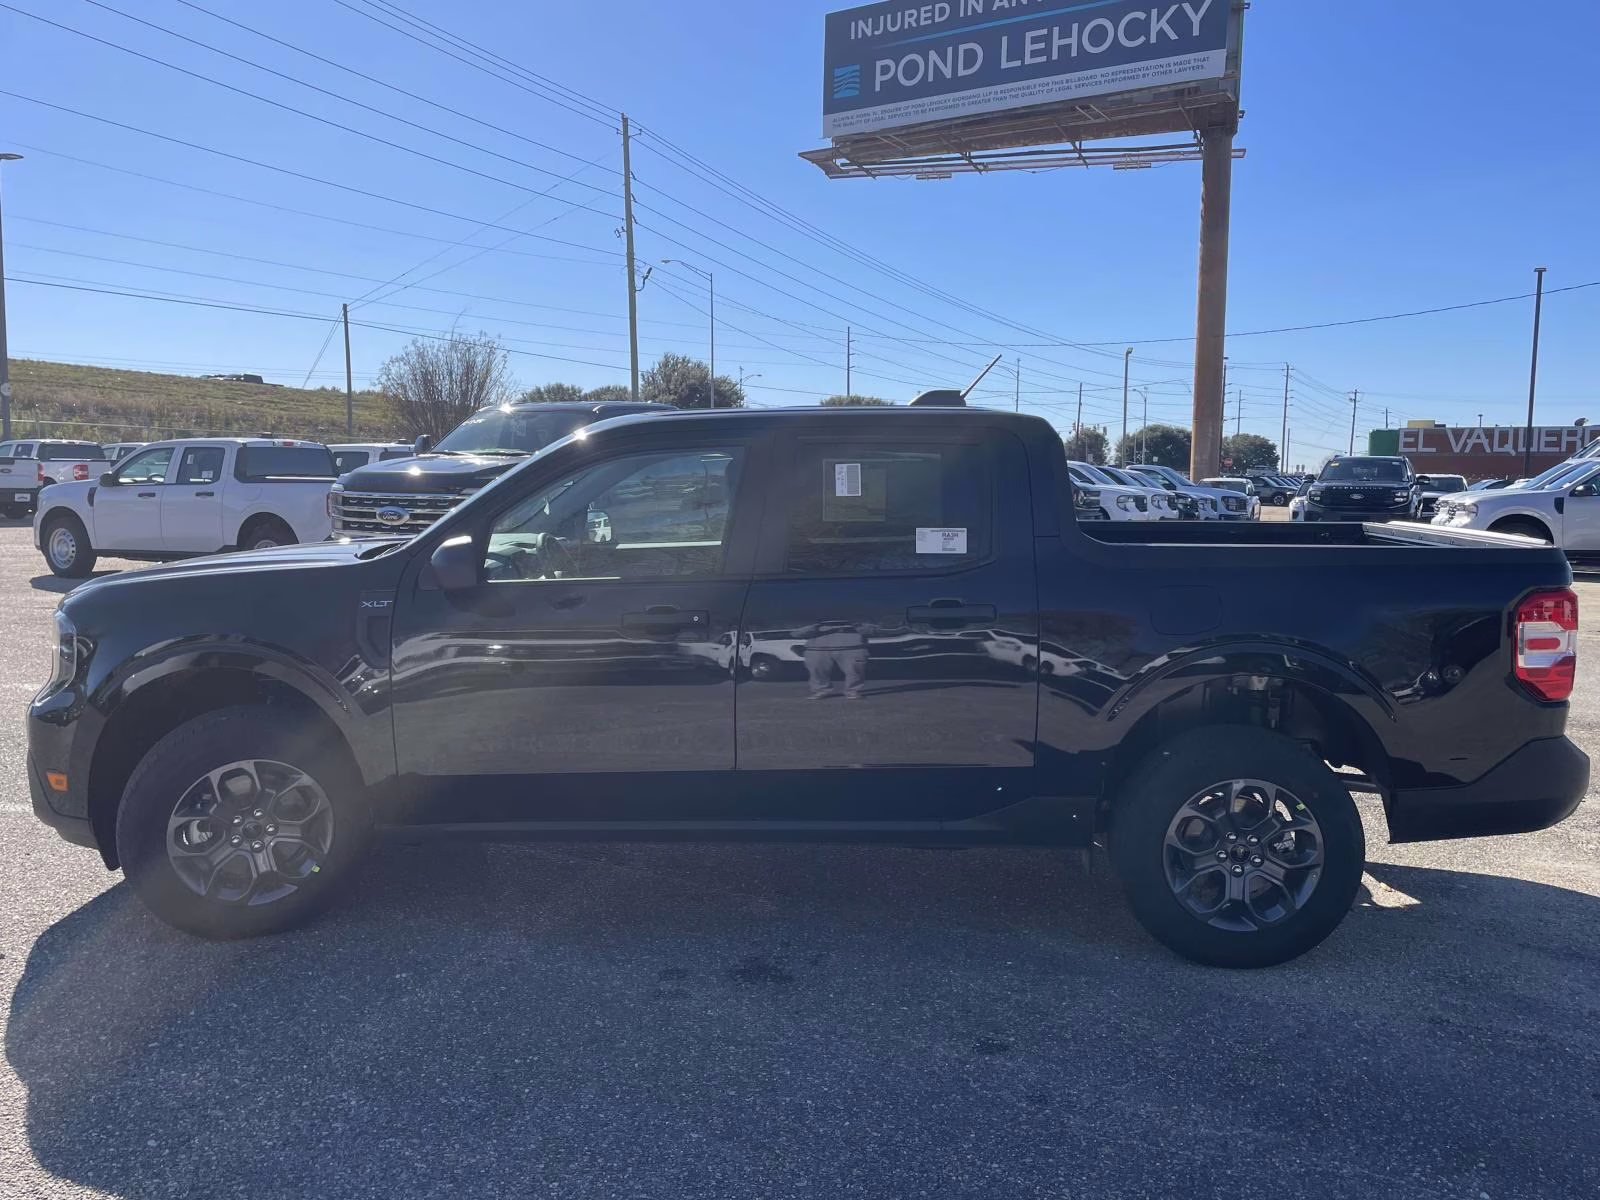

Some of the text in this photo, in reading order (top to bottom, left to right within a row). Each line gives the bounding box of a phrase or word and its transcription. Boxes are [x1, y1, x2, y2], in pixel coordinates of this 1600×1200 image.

[850, 2, 950, 40] INJURED
[959, 0, 984, 17] IN
[874, 0, 1214, 92] POND LEHOCKY
[1000, 84, 1037, 94] RESPONSIBLE
[1111, 63, 1164, 77] REPRESENTATION
[1193, 56, 1209, 64] THAT
[1020, 89, 1044, 98] QUALITY
[1055, 84, 1072, 92] LEGAL
[1074, 80, 1102, 89] SERVICES
[1104, 74, 1140, 85] PERFORMED
[1152, 69, 1172, 77] OTHER
[1400, 428, 1437, 453] EL
[361, 600, 392, 608] XLT
